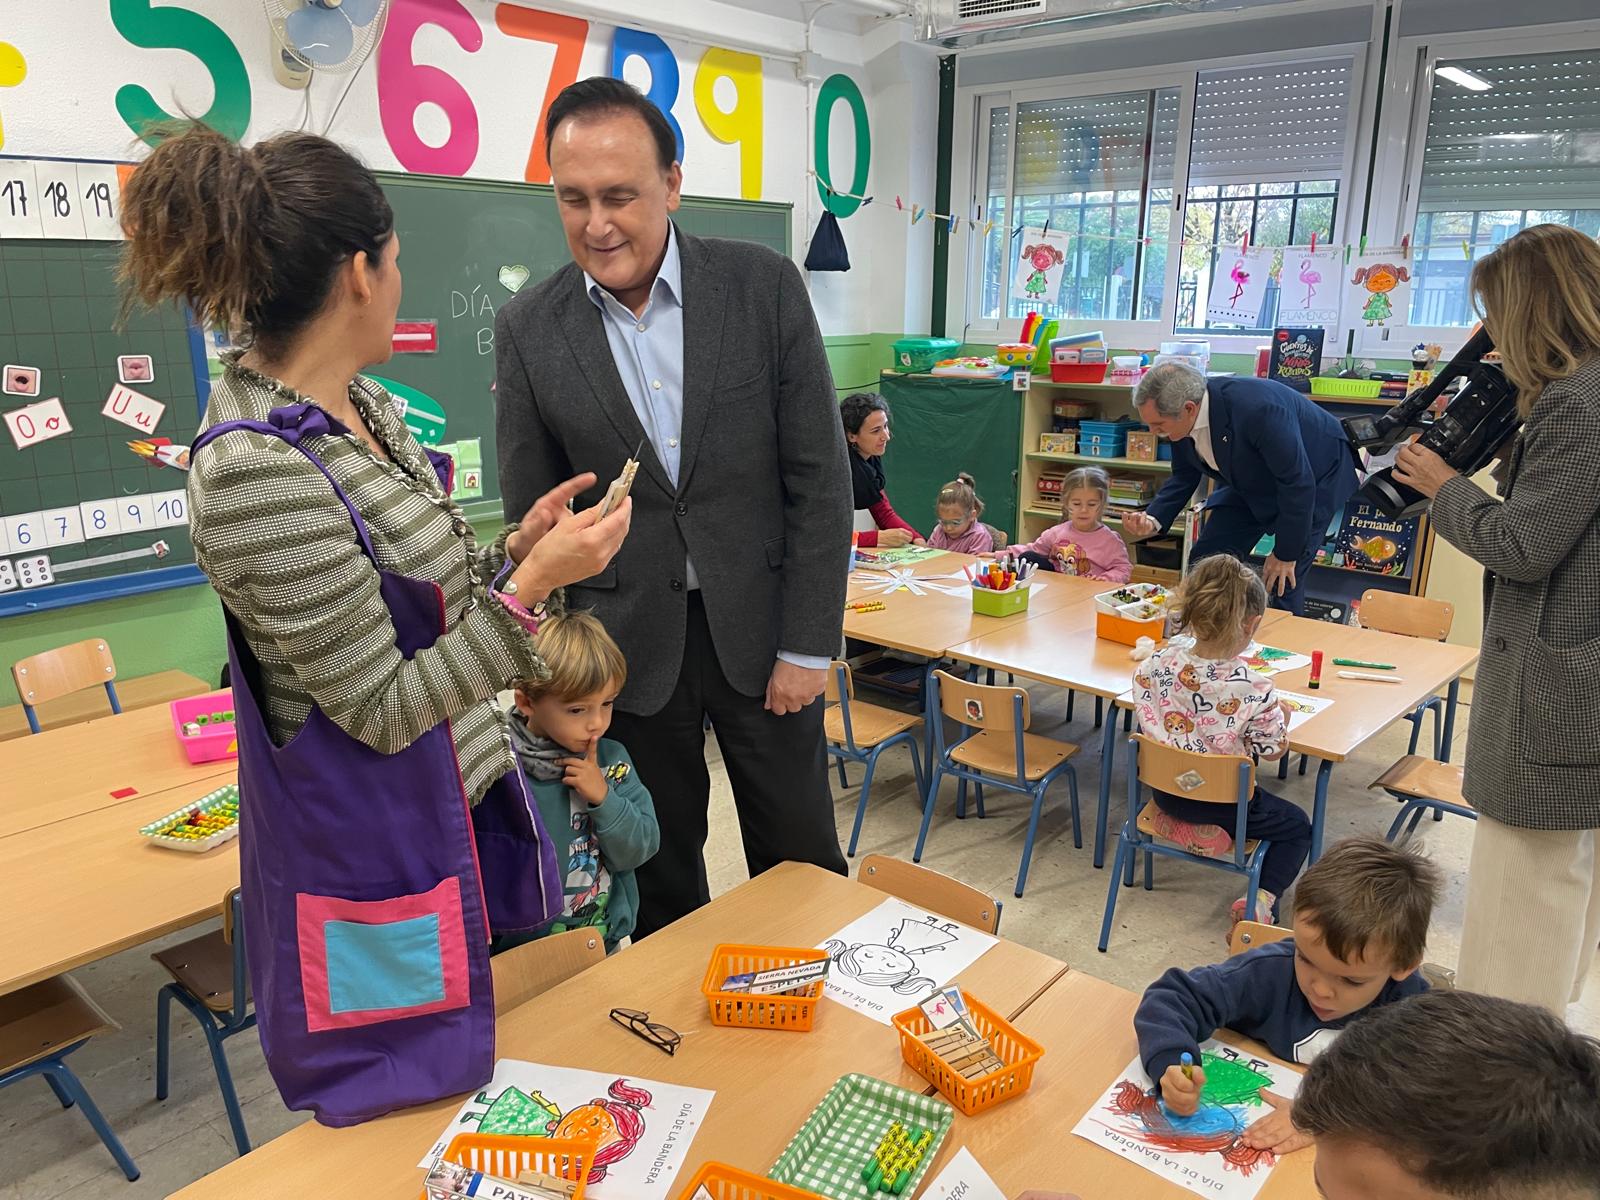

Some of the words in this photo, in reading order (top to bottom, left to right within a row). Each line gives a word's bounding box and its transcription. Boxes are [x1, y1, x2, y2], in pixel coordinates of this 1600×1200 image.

[377, 0, 484, 177] 6
[495, 3, 589, 184] 7
[693, 46, 763, 201] 9
[814, 73, 871, 218] 0
[2, 180, 28, 217] 17
[44, 181, 71, 217] 18
[85, 182, 114, 218] 19
[450, 284, 497, 319] DÍA
[112, 390, 132, 415] U
[135, 411, 152, 427] u
[16, 414, 36, 439] O
[45, 417, 60, 430] o
[1357, 504, 1370, 515] El
[17, 523, 32, 545] 6
[54, 516, 69, 538] 7
[92, 509, 107, 530] 8
[127, 504, 142, 524] 9
[157, 499, 184, 520] 10
[1350, 516, 1403, 533] Fernando
[757, 970, 787, 981] SIERRA
[787, 964, 822, 976] NEVADA
[842, 989, 855, 998] LA
[853, 994, 867, 1004] DE
[678, 1102, 693, 1118] DÍA
[672, 1118, 685, 1131] DE
[667, 1131, 679, 1142] LA
[1103, 1129, 1162, 1161] BANDERA
[644, 1143, 673, 1184] BANDERA
[1164, 1157, 1179, 1170] LA
[1182, 1166, 1197, 1179] DE
